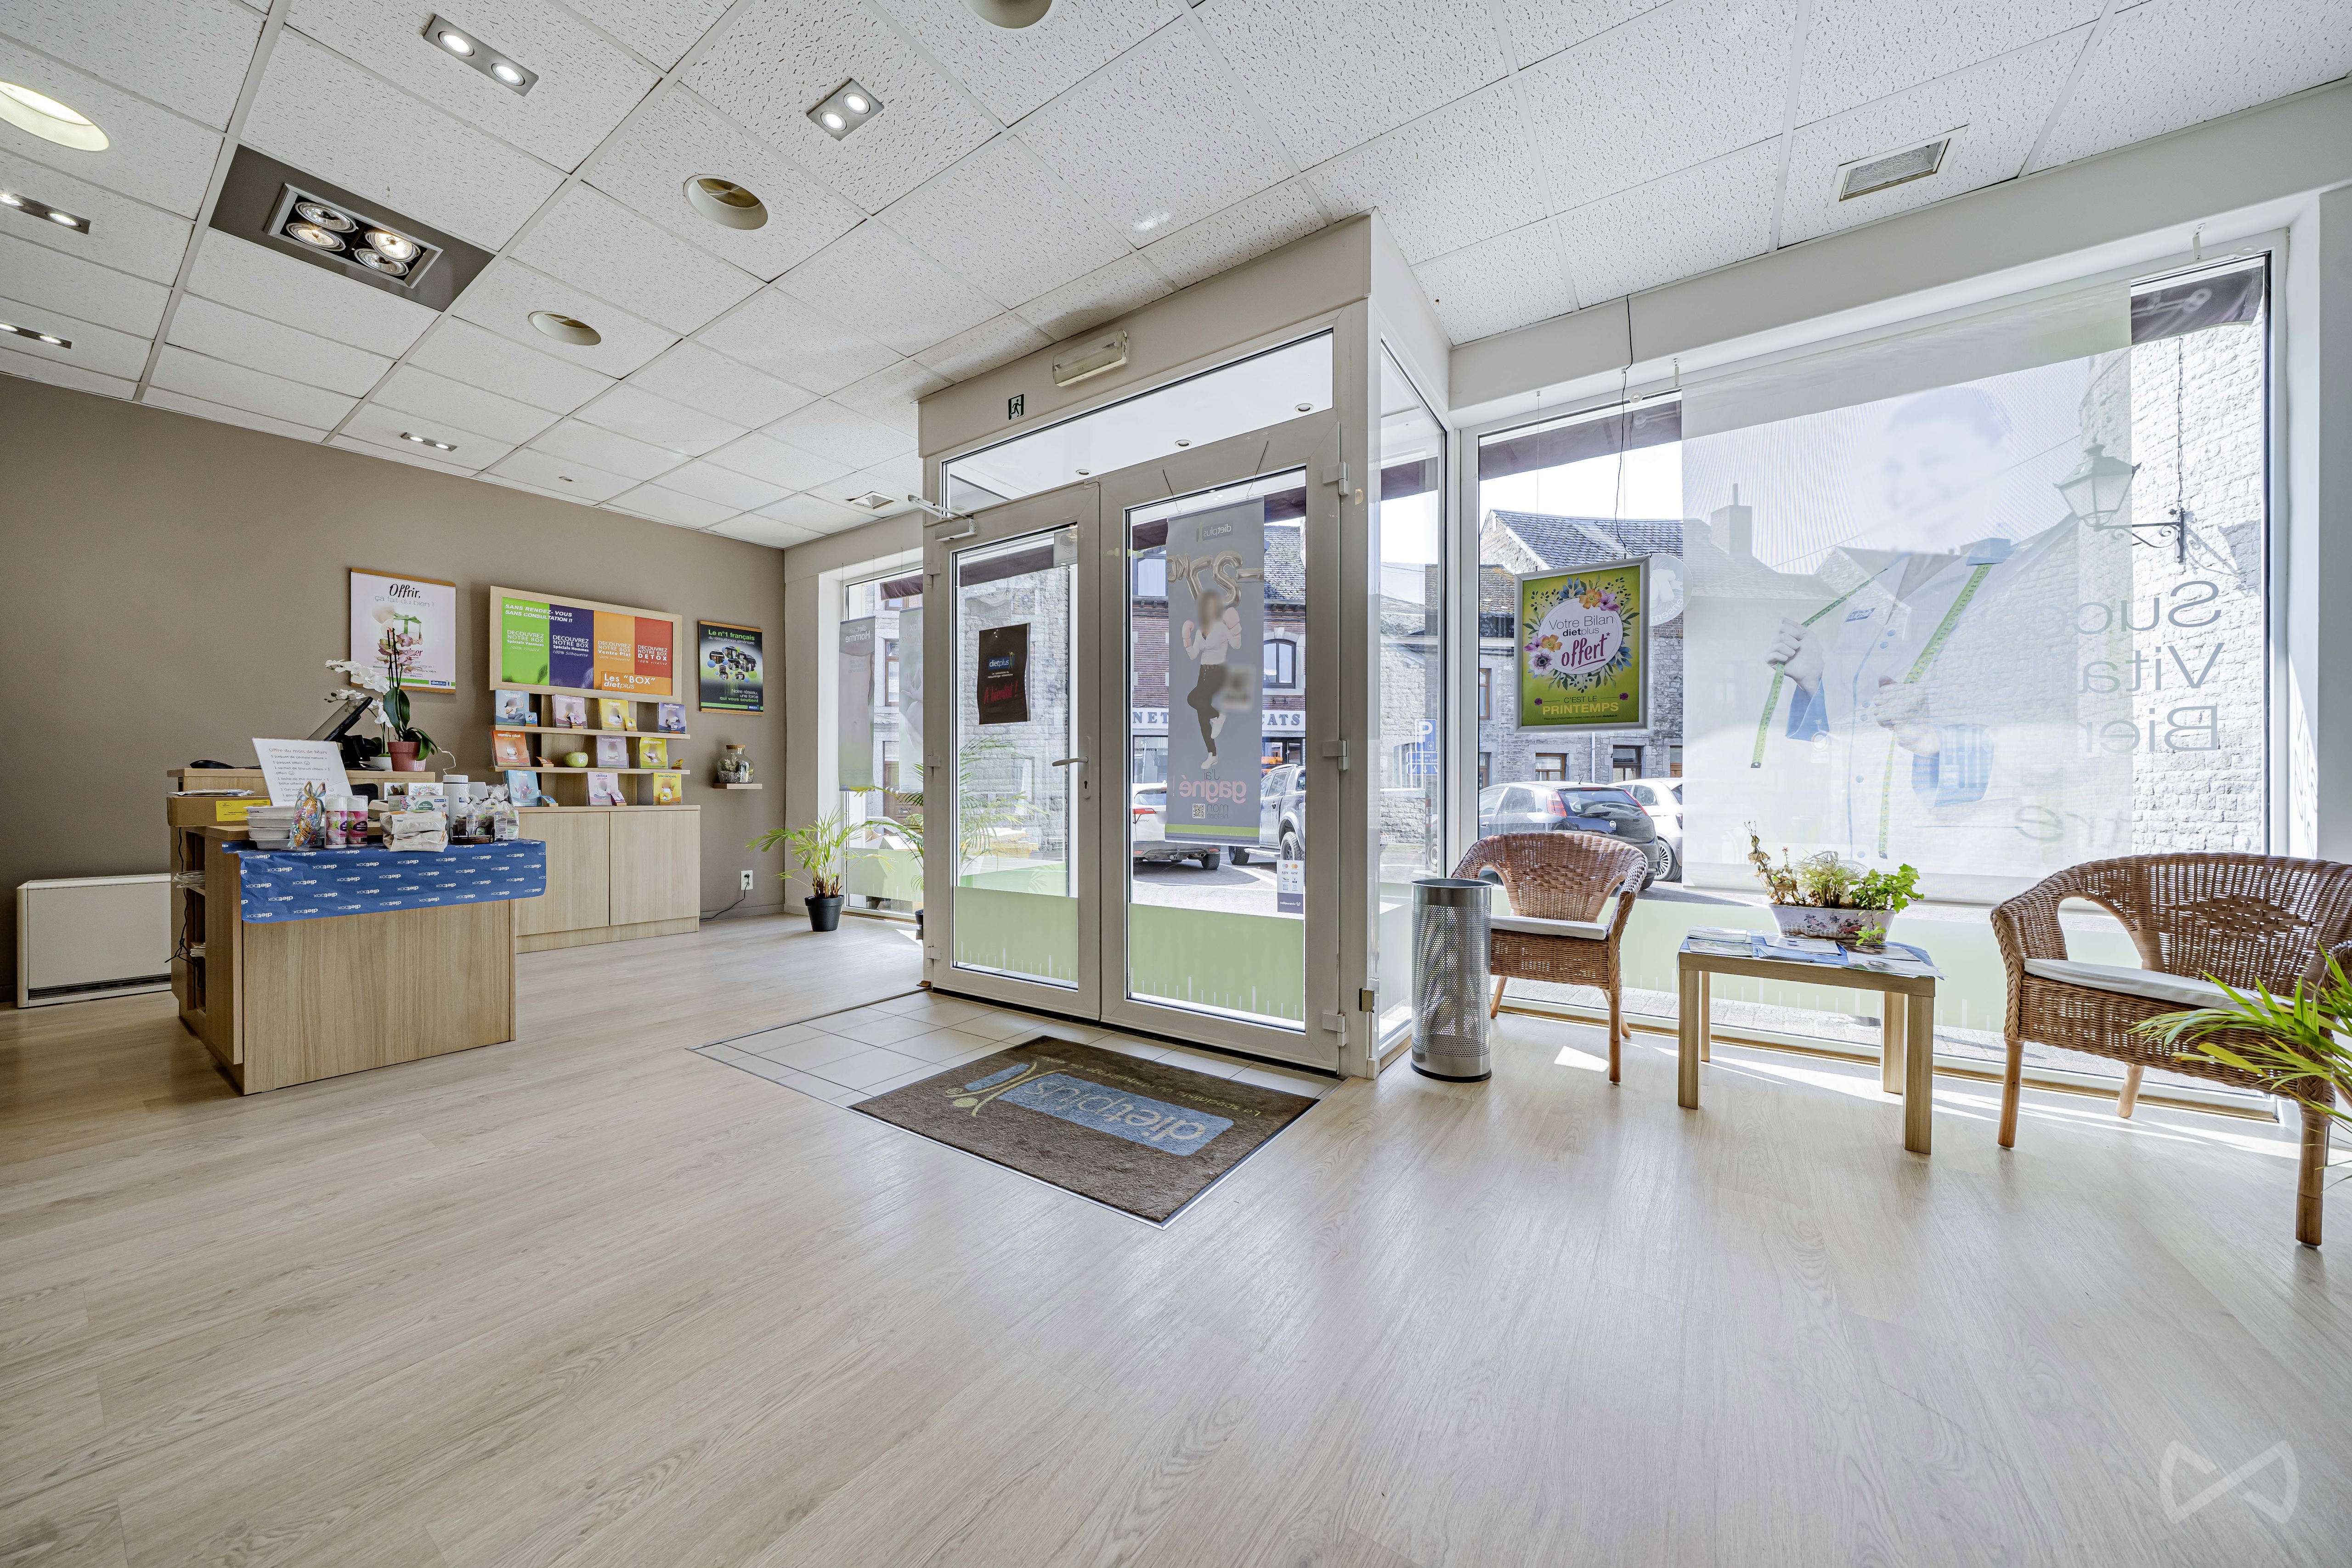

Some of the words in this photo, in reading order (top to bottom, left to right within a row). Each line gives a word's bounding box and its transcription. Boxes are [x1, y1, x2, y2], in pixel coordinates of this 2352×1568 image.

[389, 583, 421, 598] Offrir,
[523, 613, 567, 622] CONSULTATION
[1549, 617, 1580, 630] Votre
[1584, 614, 1614, 628] Bilan
[507, 630, 544, 639] DECOUVREZ
[730, 632, 755, 641] français
[1562, 627, 1600, 637] dietplus
[553, 635, 589, 644] DECOUVREZ
[989, 659, 1009, 668] dietplus
[604, 673, 620, 682] Les
[1543, 702, 1619, 715] PRINTEMPS
[1262, 713, 1300, 726] ATS
[1419, 721, 1433, 742] P
[1026, 1081, 1206, 1141] dietplus
